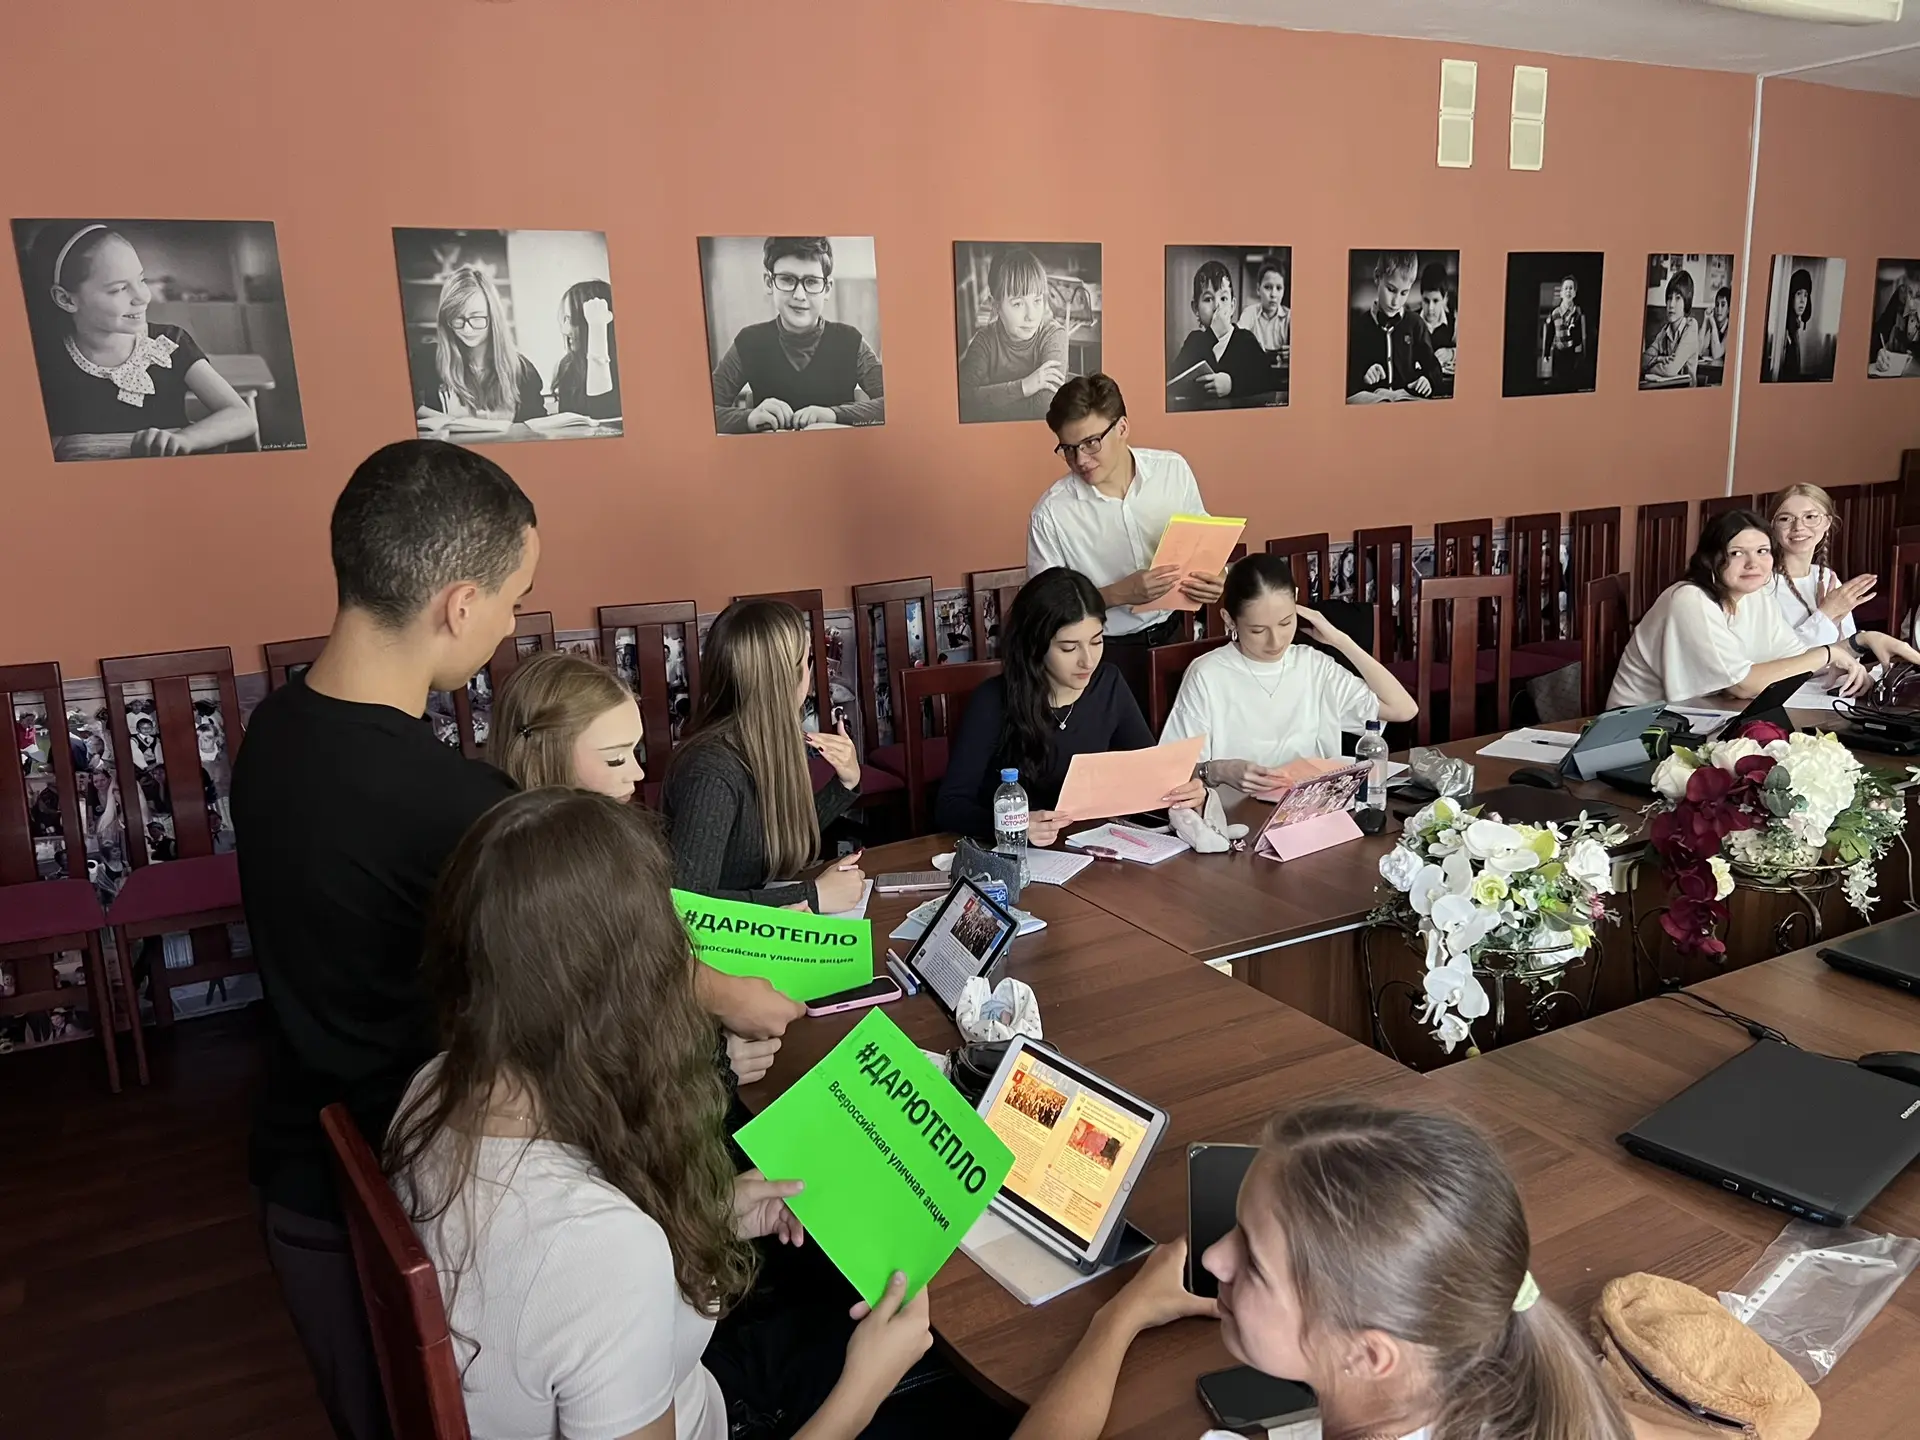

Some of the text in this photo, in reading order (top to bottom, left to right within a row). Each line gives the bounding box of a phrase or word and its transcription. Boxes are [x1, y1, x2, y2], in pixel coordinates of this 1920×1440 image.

[685, 910, 858, 946] #ДАРЮТЕПЛО
[694, 944, 767, 959] российская
[769, 954, 817, 964] уличная
[828, 1080, 950, 1232] Всероссийская уличная акция
[855, 1041, 987, 1194] #ДАРЮТЕПЛО
